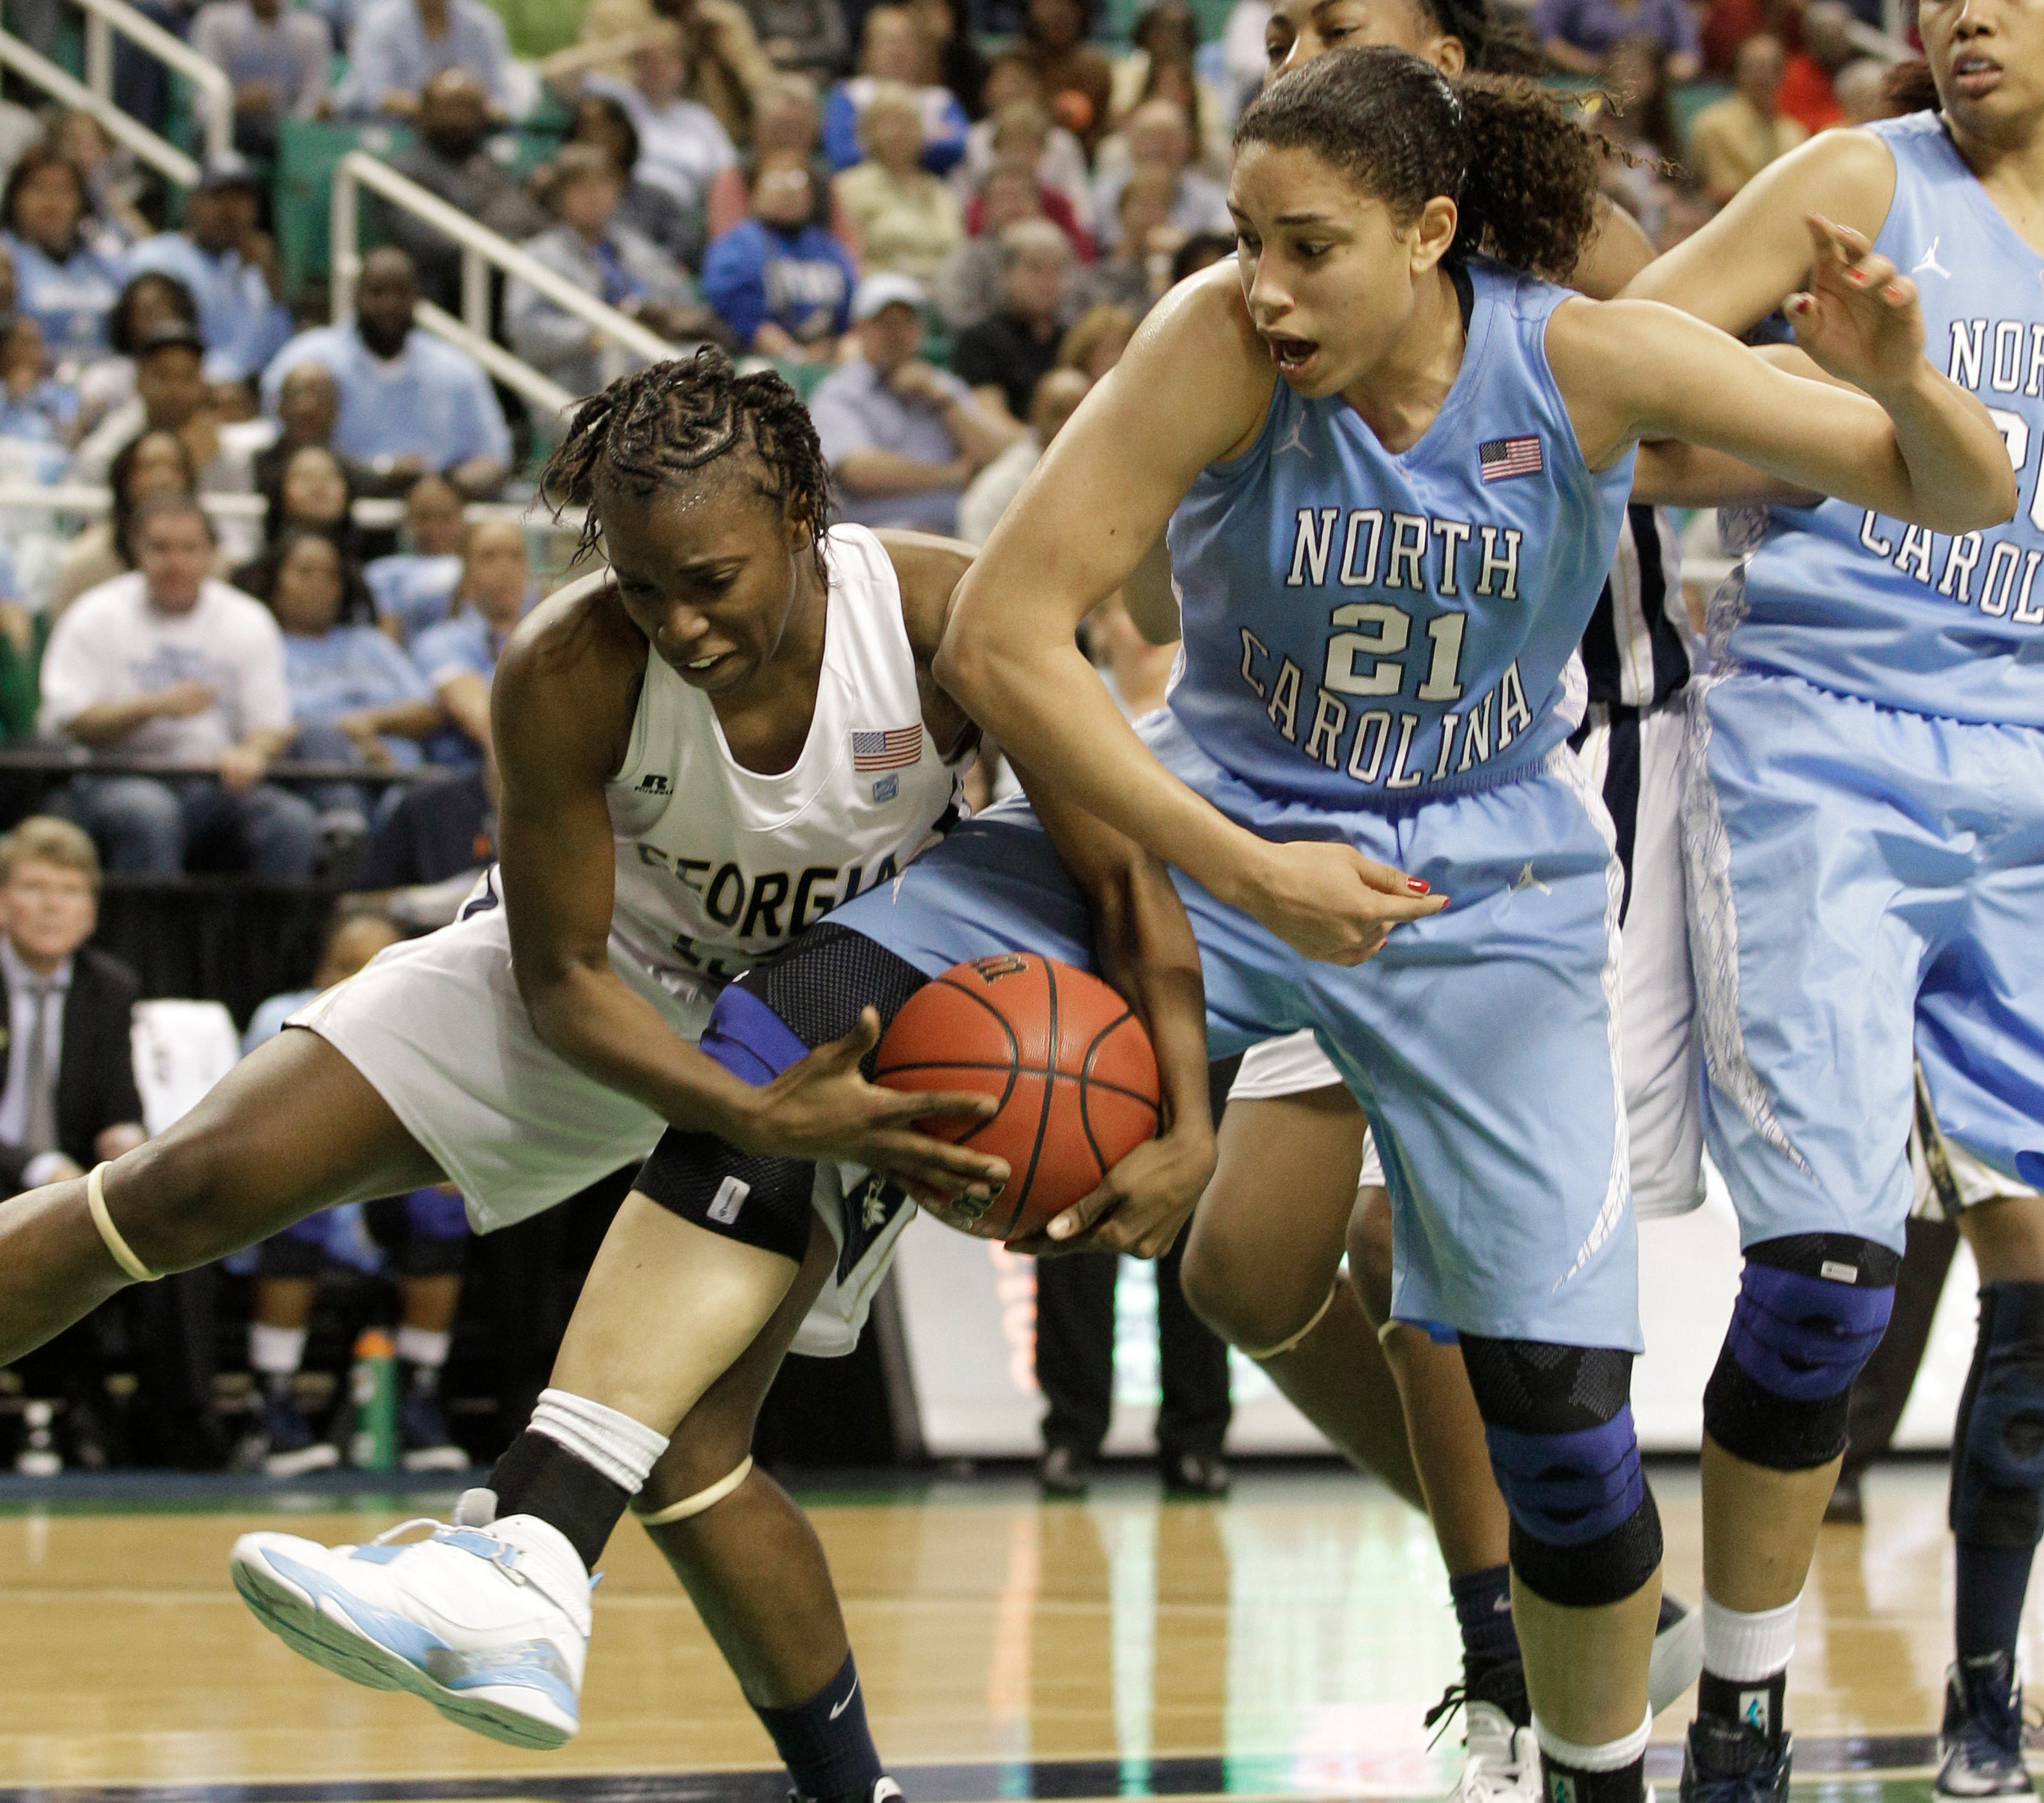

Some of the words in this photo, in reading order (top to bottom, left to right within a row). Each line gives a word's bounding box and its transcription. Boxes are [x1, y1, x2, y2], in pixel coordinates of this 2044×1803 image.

[1285, 507, 1524, 600] NORTH
[1322, 600, 1469, 703] 21
[1238, 626, 1534, 790] CAROLINA
